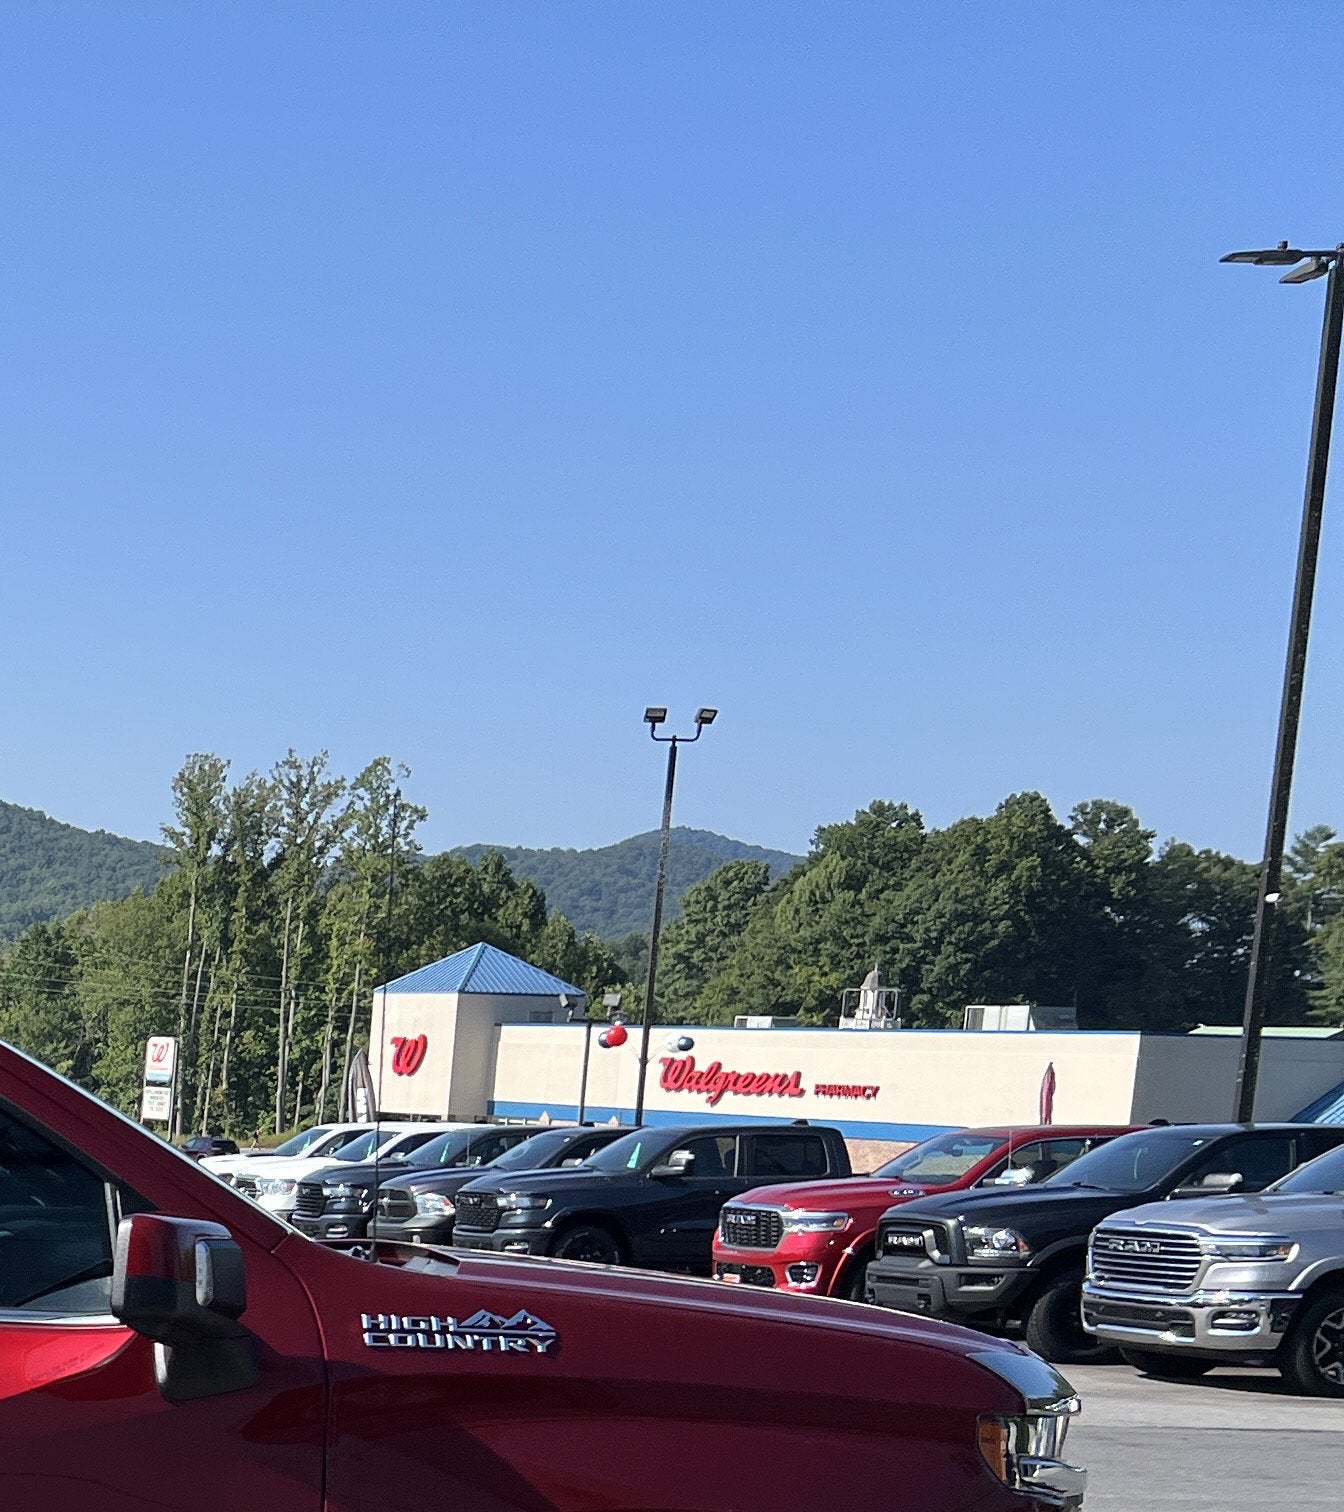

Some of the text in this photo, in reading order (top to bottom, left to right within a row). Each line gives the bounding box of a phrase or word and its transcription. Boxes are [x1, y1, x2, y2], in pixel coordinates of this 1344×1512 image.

[152, 1042, 169, 1063] W
[390, 1033, 428, 1077] W
[658, 1055, 880, 1108] Walgreens PHARMACY
[1108, 1238, 1161, 1253] RAM
[360, 1312, 459, 1332] HIGH
[362, 1331, 557, 1354] COUNTRY
